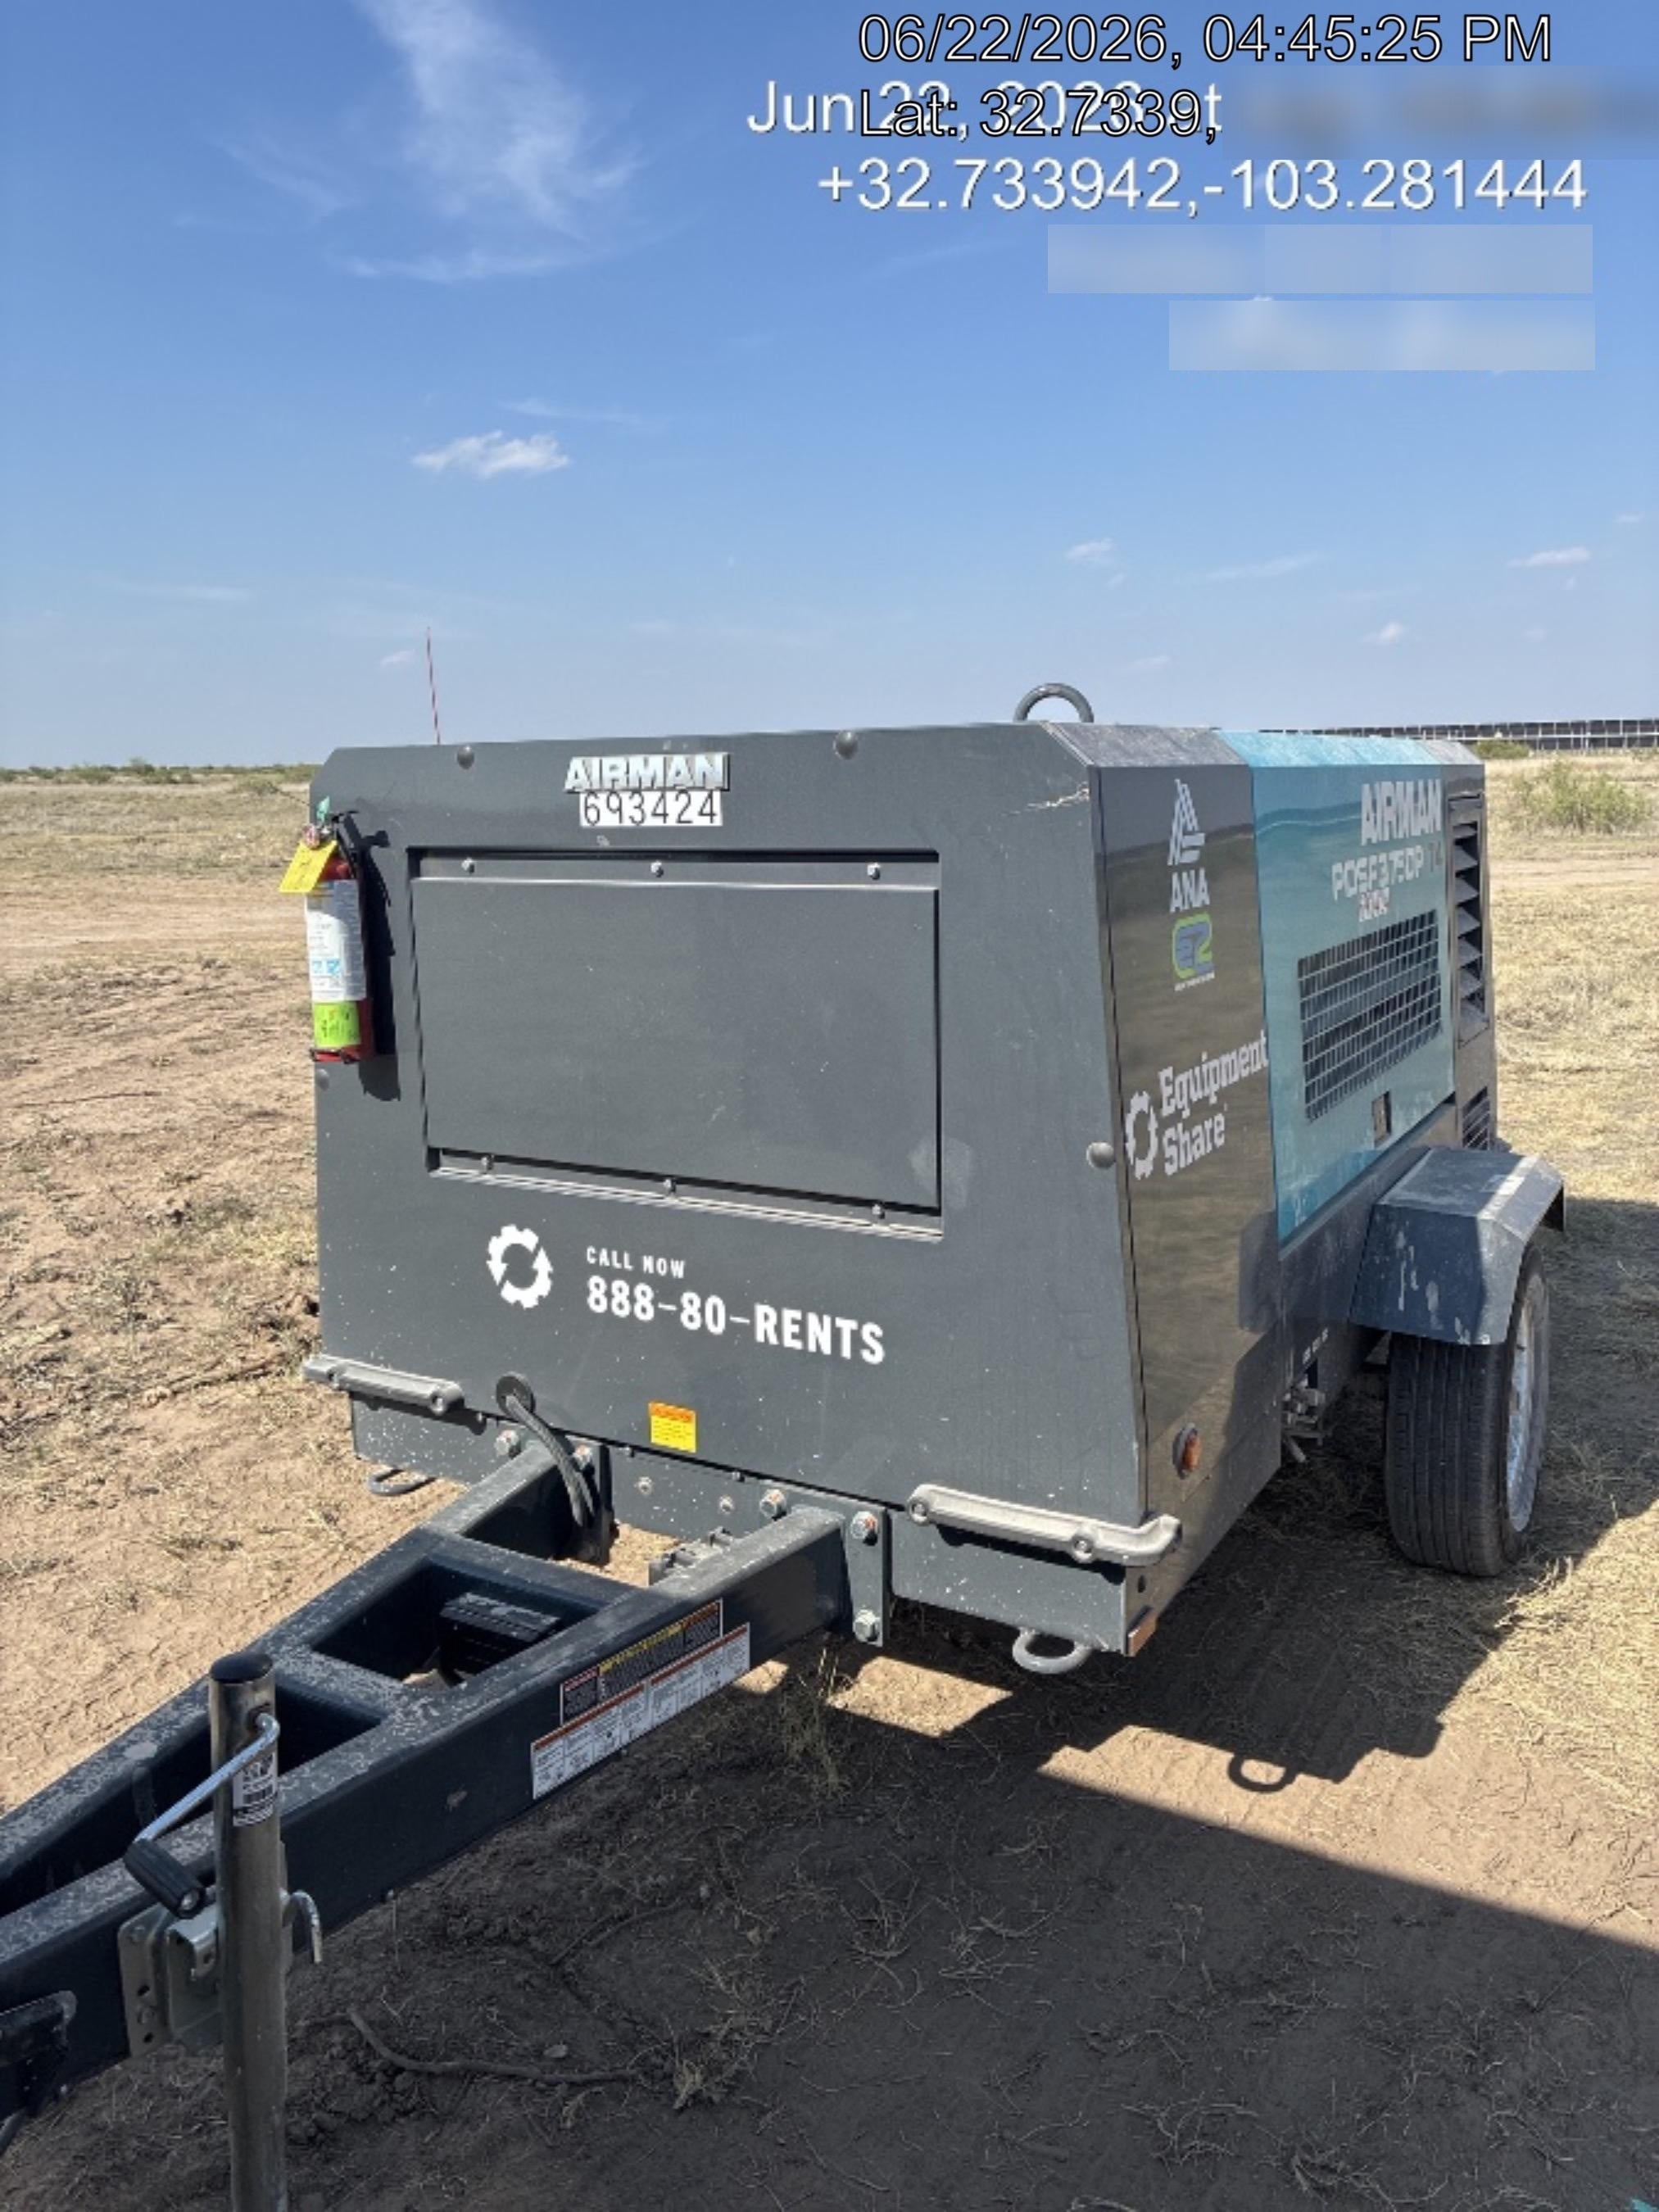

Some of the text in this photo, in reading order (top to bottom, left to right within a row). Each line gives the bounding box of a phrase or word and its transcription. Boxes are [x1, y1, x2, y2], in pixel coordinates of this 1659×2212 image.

[564, 751, 729, 791] AIRMAN
[584, 789, 717, 826] 693424
[1361, 779, 1442, 846] AIRMAN
[1169, 867, 1211, 913] ANA
[1158, 1029, 1269, 1118] Equipment
[1162, 1122, 1226, 1176] Share
[586, 1245, 687, 1279] CALL NOW
[587, 1275, 886, 1365] 888-80-RENTS
